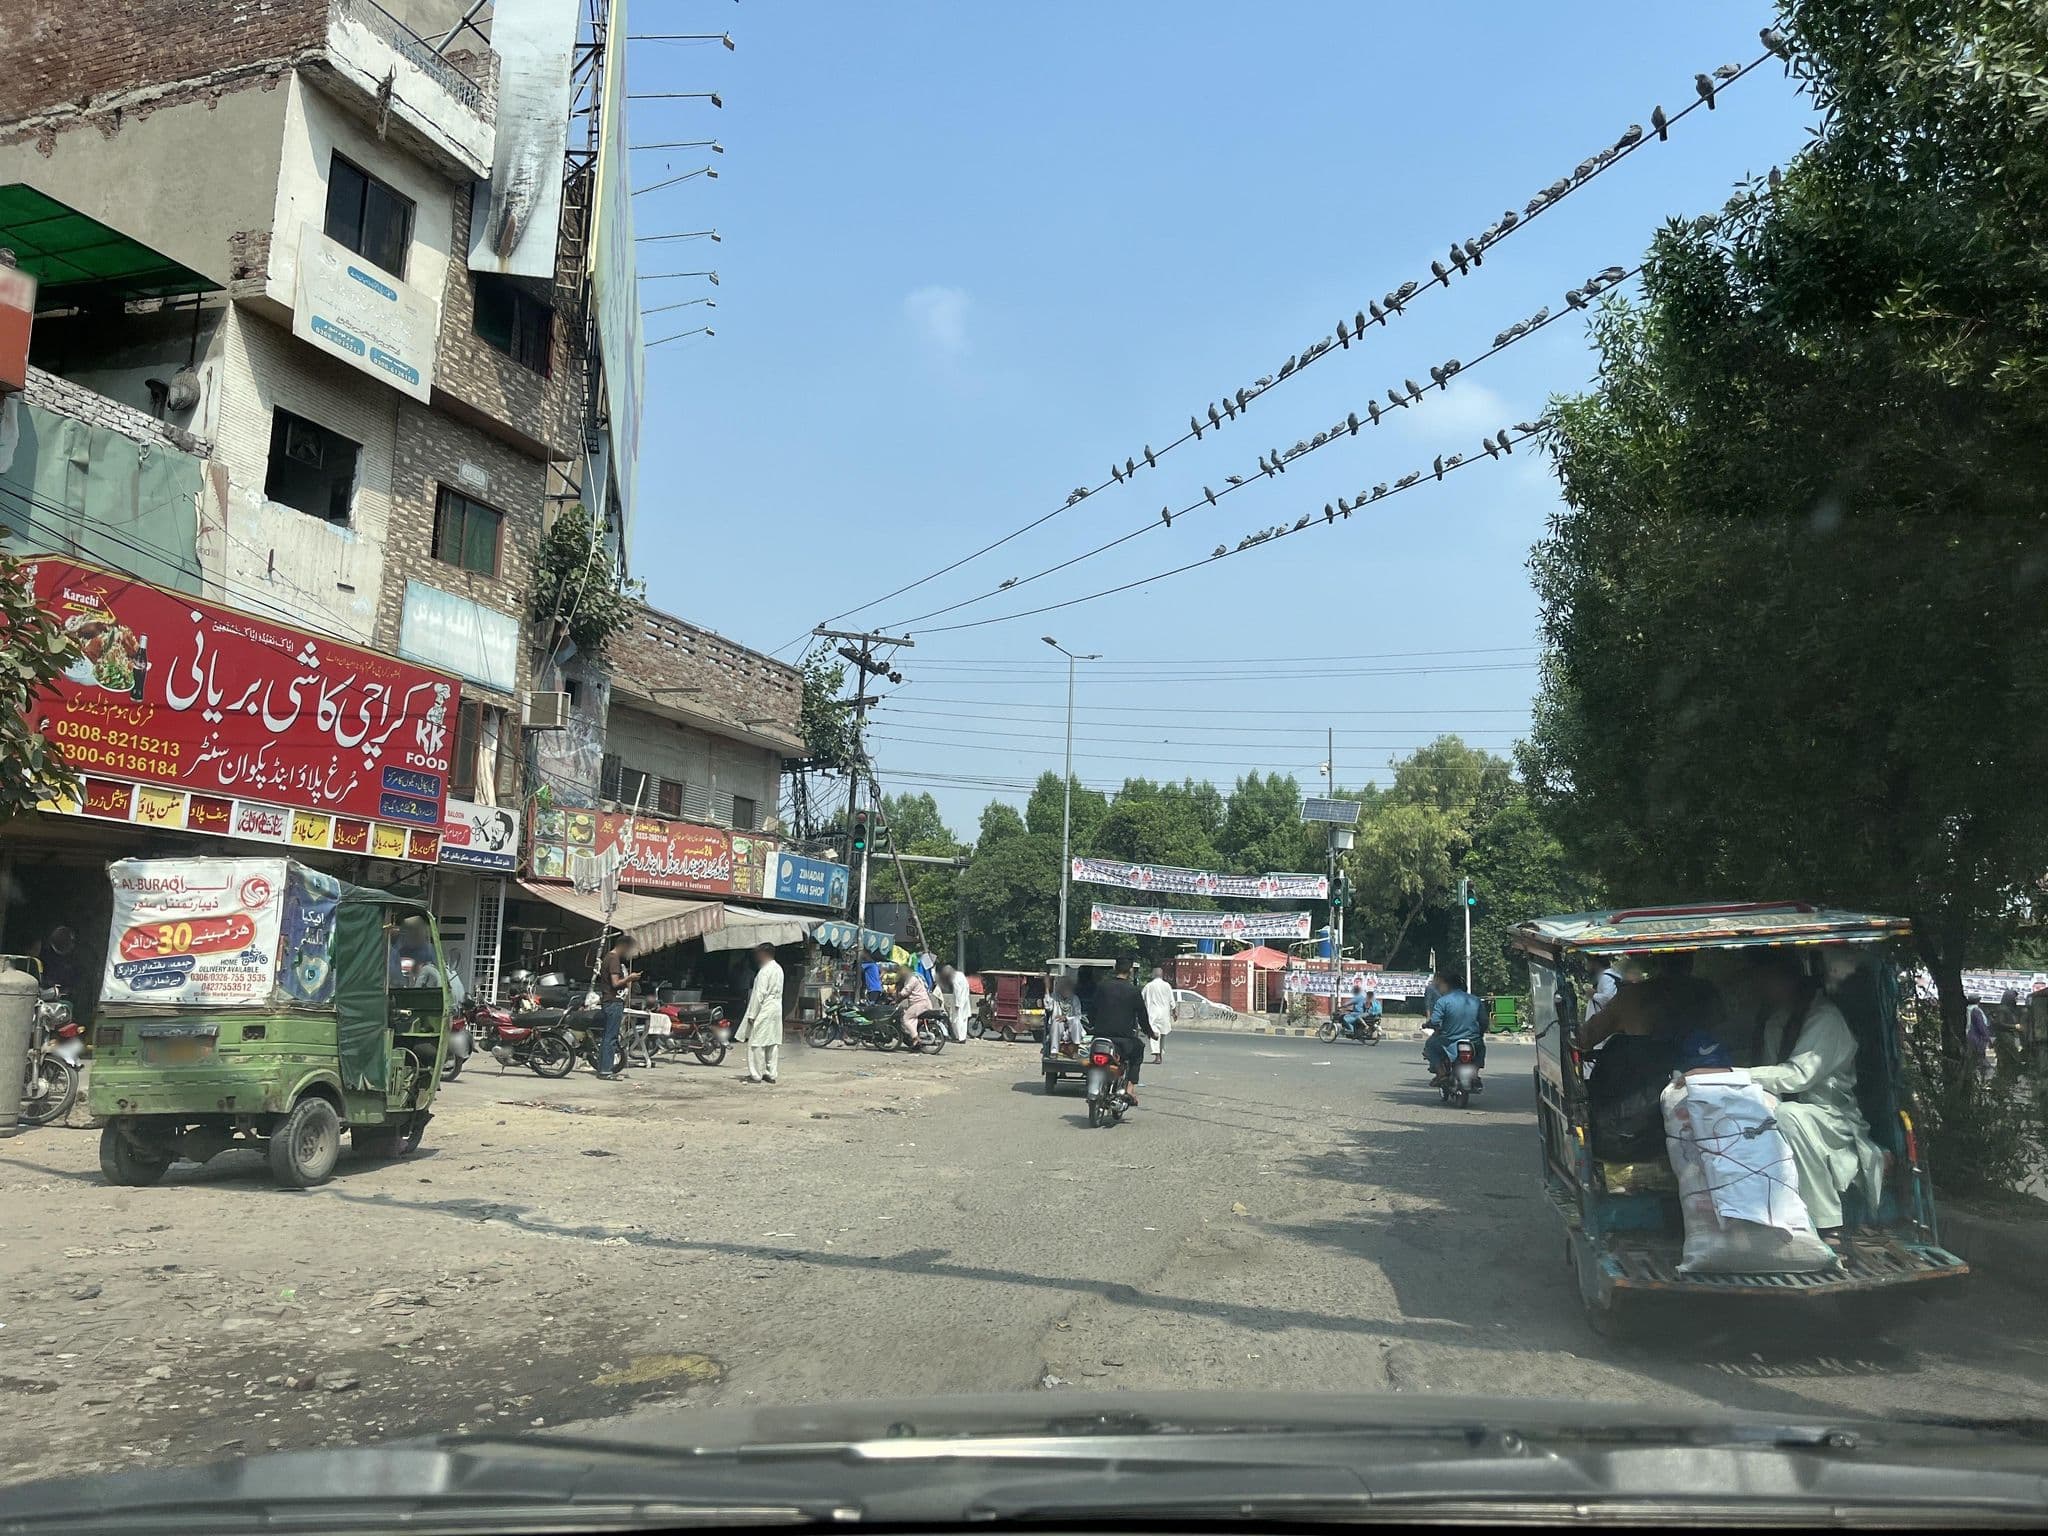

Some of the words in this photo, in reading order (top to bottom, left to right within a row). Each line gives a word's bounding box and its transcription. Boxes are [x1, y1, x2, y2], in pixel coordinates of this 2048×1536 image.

[63, 587, 99, 607] Karachi
[166, 609, 263, 723] بریانی
[262, 641, 357, 733] کاشی
[66, 691, 108, 716] ڈلیوری
[107, 706, 130, 726] ہوم
[129, 703, 154, 727] فری
[56, 720, 180, 757] 0308-8215213
[334, 681, 433, 771] کراچی
[56, 743, 177, 777] 0300-6136184
[218, 741, 277, 790] پکوان
[406, 752, 448, 772] FOOD
[410, 803, 417, 815] 2
[122, 878, 180, 893] AL-BURAQ
[796, 882, 809, 894] PAN
[809, 885, 825, 898] SHOP
[157, 922, 193, 955] 30
